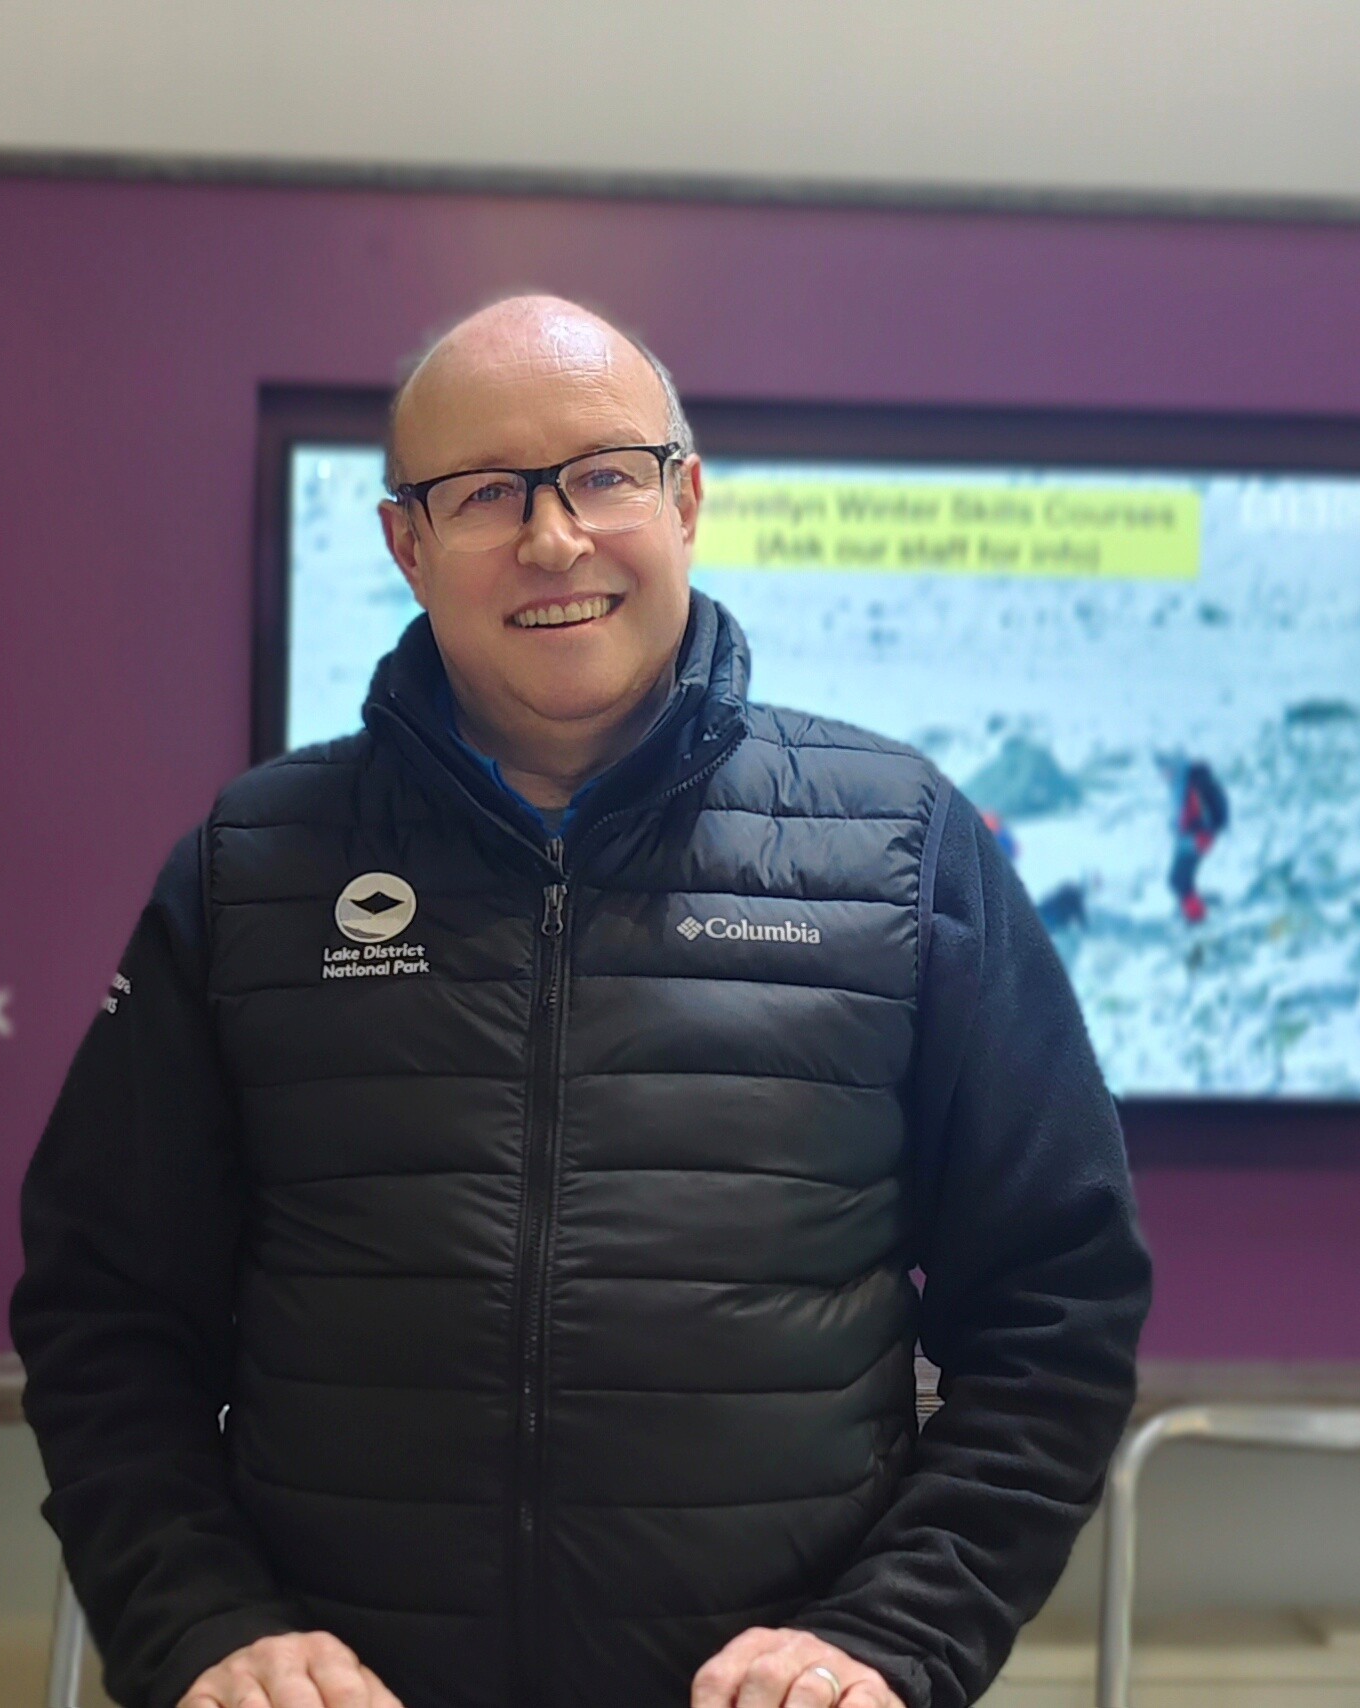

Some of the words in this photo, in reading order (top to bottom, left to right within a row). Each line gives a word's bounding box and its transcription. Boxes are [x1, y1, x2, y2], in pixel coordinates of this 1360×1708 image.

[837, 492, 940, 522] Winter
[950, 492, 1034, 525] Skills
[1042, 496, 1177, 529] Courses
[835, 540, 887, 563] our
[897, 533, 969, 566] staff
[977, 534, 1021, 565] for
[704, 917, 821, 944] Columbia
[324, 947, 360, 962] Lake
[363, 942, 426, 960] District
[322, 961, 390, 979] National
[393, 958, 430, 975] Park
